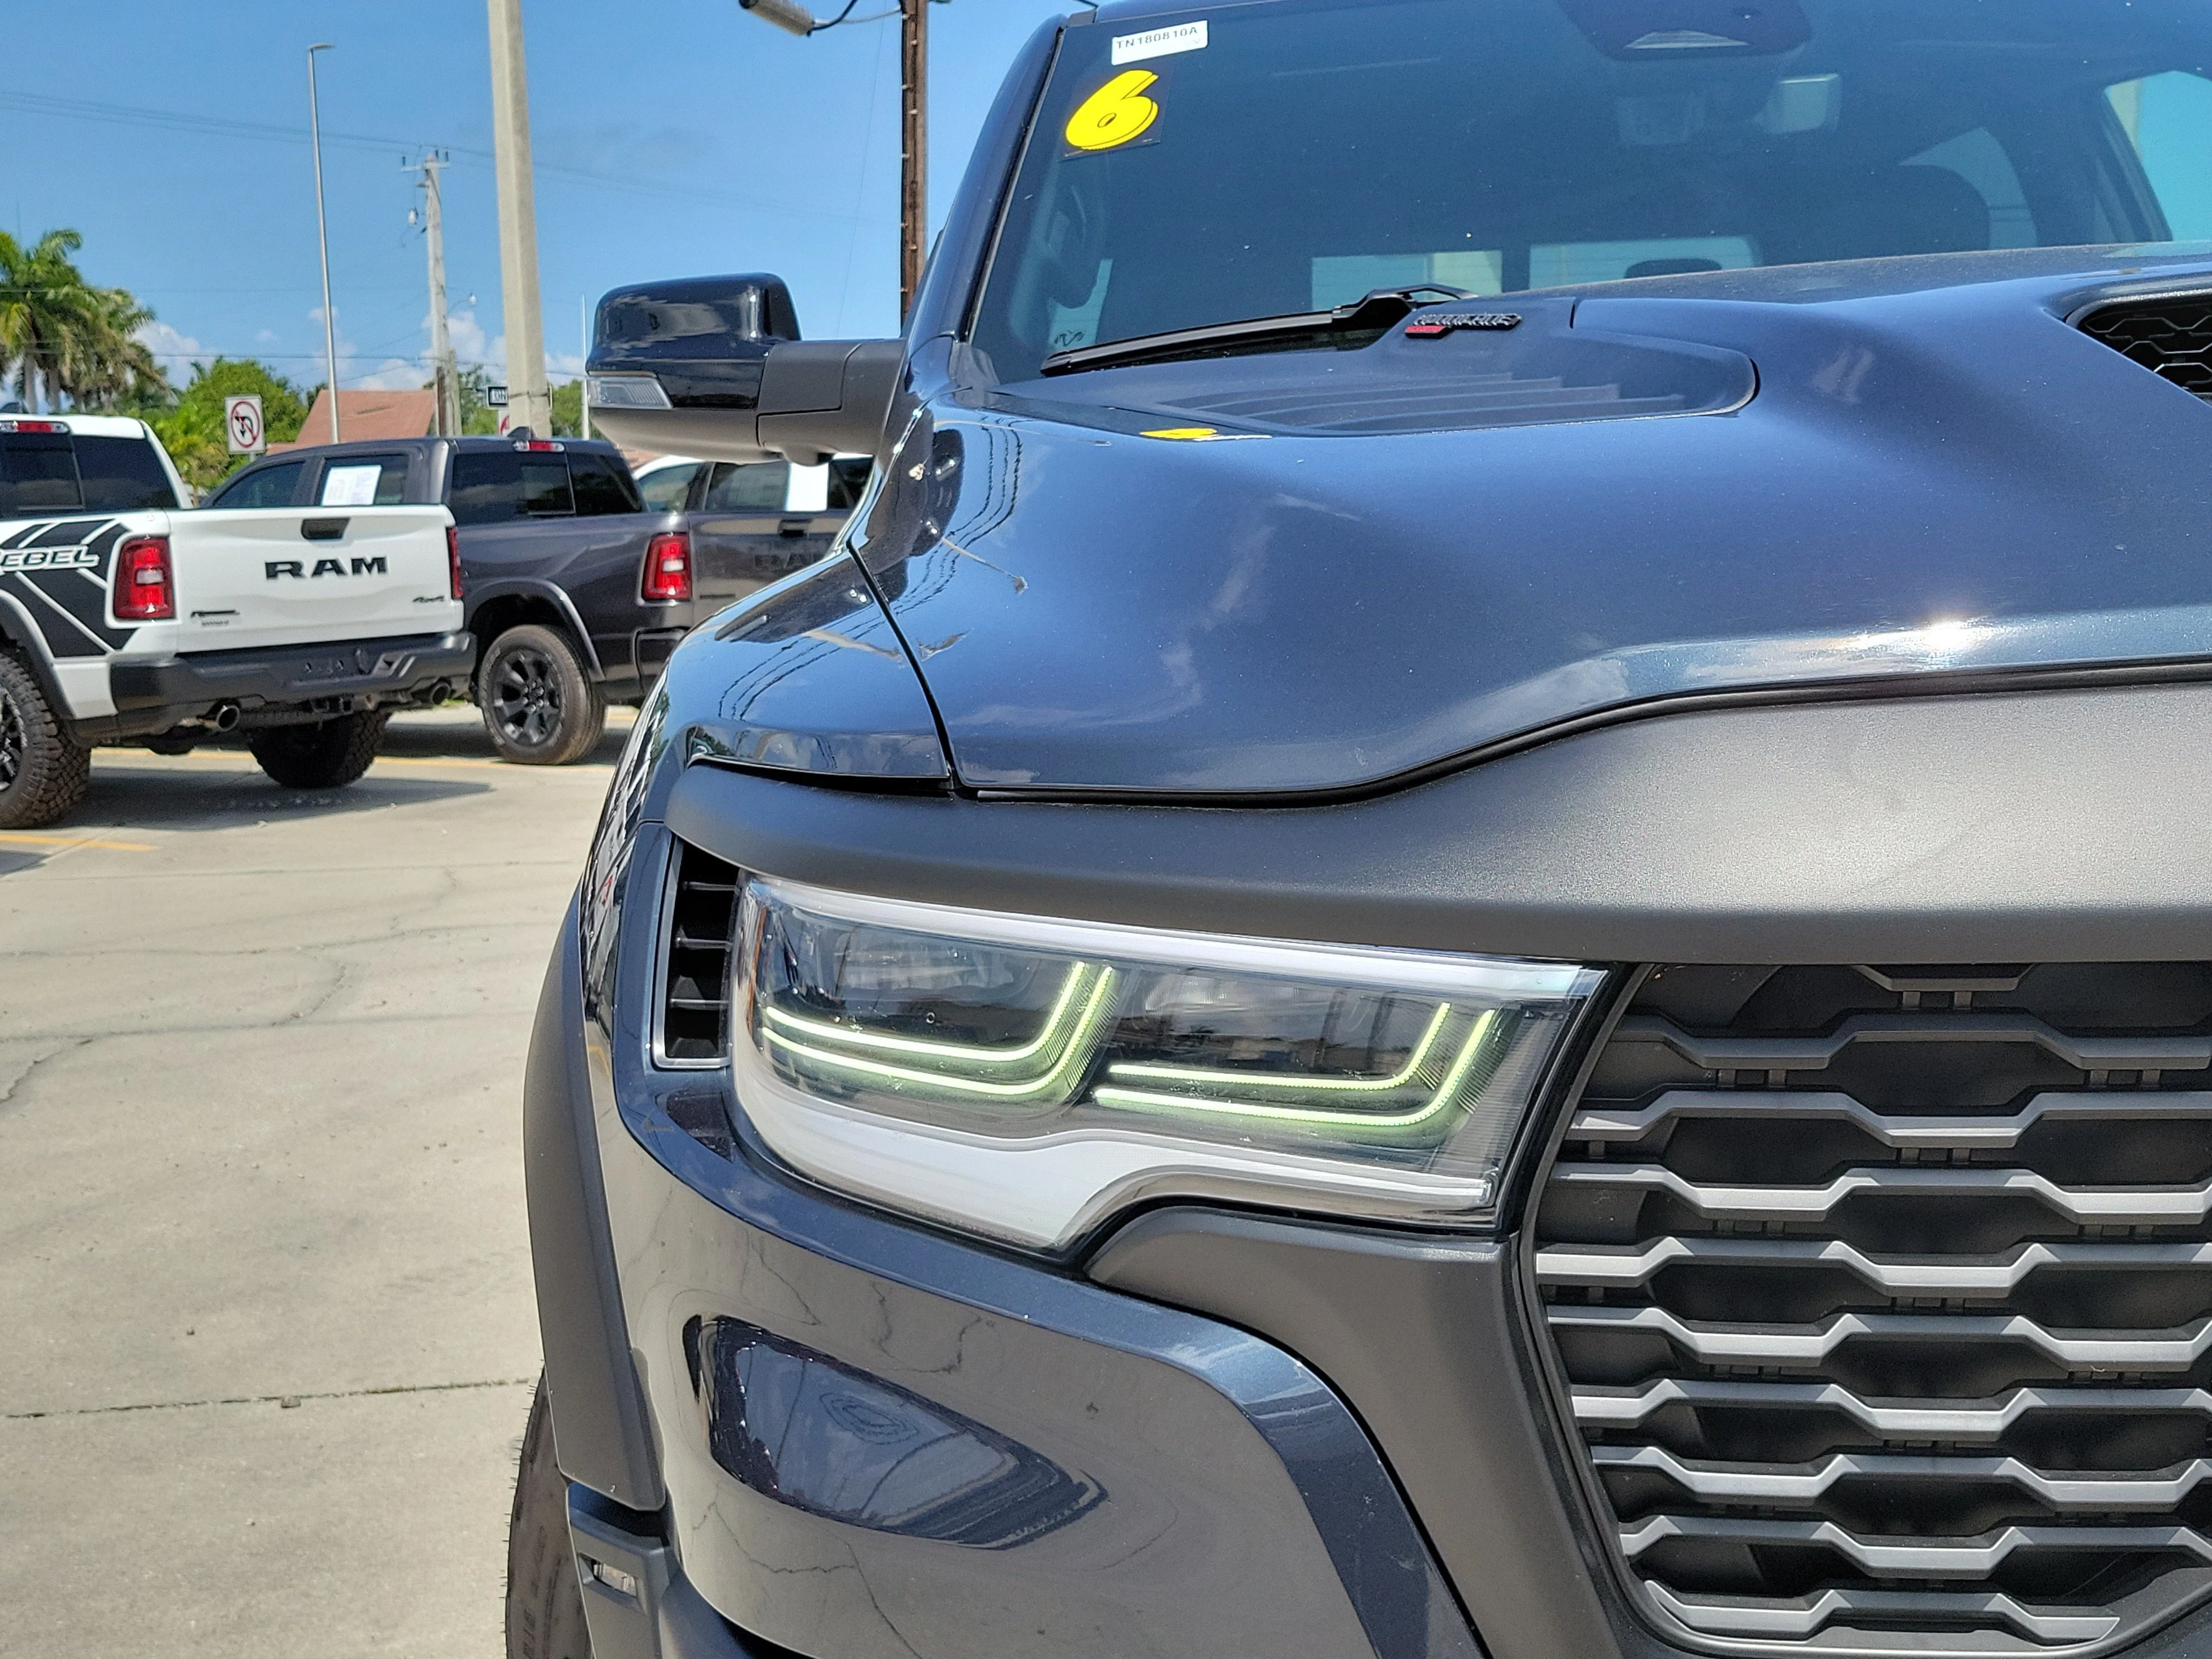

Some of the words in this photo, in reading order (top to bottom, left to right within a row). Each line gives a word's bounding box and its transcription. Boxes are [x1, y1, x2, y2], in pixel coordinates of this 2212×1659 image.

[1116, 27, 1197, 49] TN180810A
[1066, 70, 1159, 150] 6
[0, 546, 98, 569] EBEL
[266, 556, 387, 580] RAM
